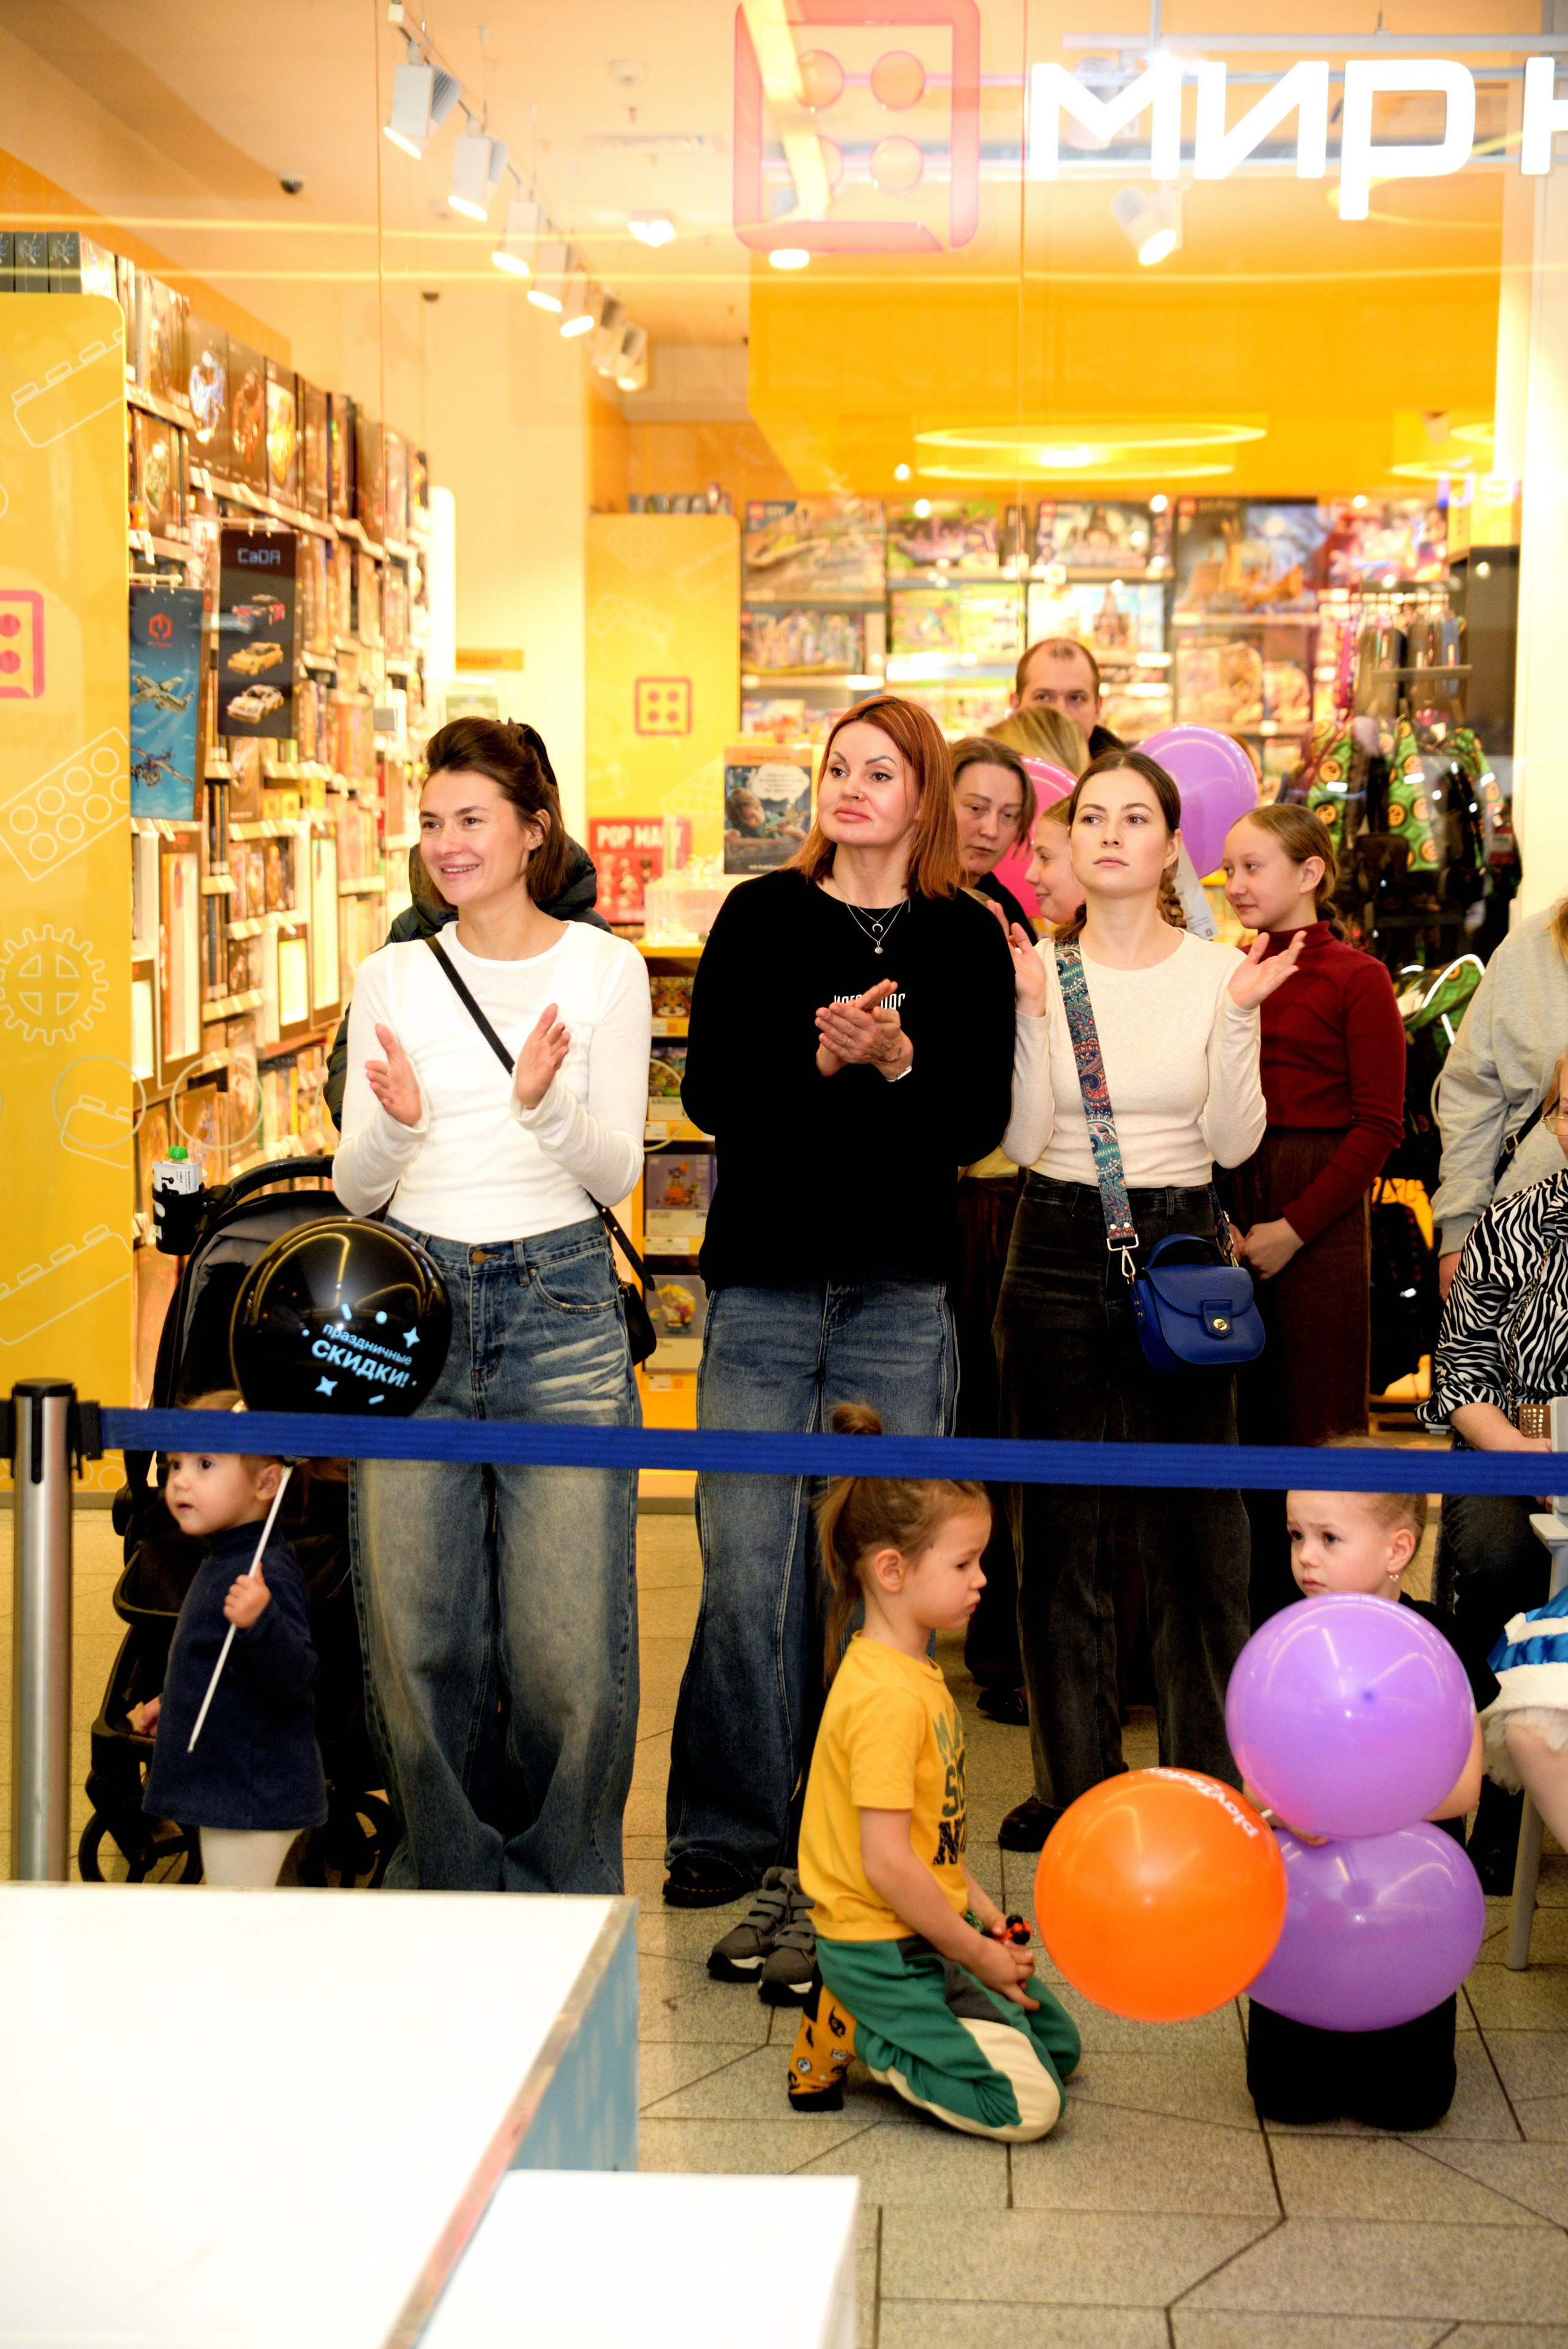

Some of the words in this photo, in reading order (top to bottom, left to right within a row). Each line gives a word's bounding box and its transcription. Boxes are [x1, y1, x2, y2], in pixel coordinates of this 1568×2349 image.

[238, 549, 281, 565] CaDA
[312, 1340, 410, 1388] СКИДКИ!
[322, 1324, 412, 1366] праздничные
